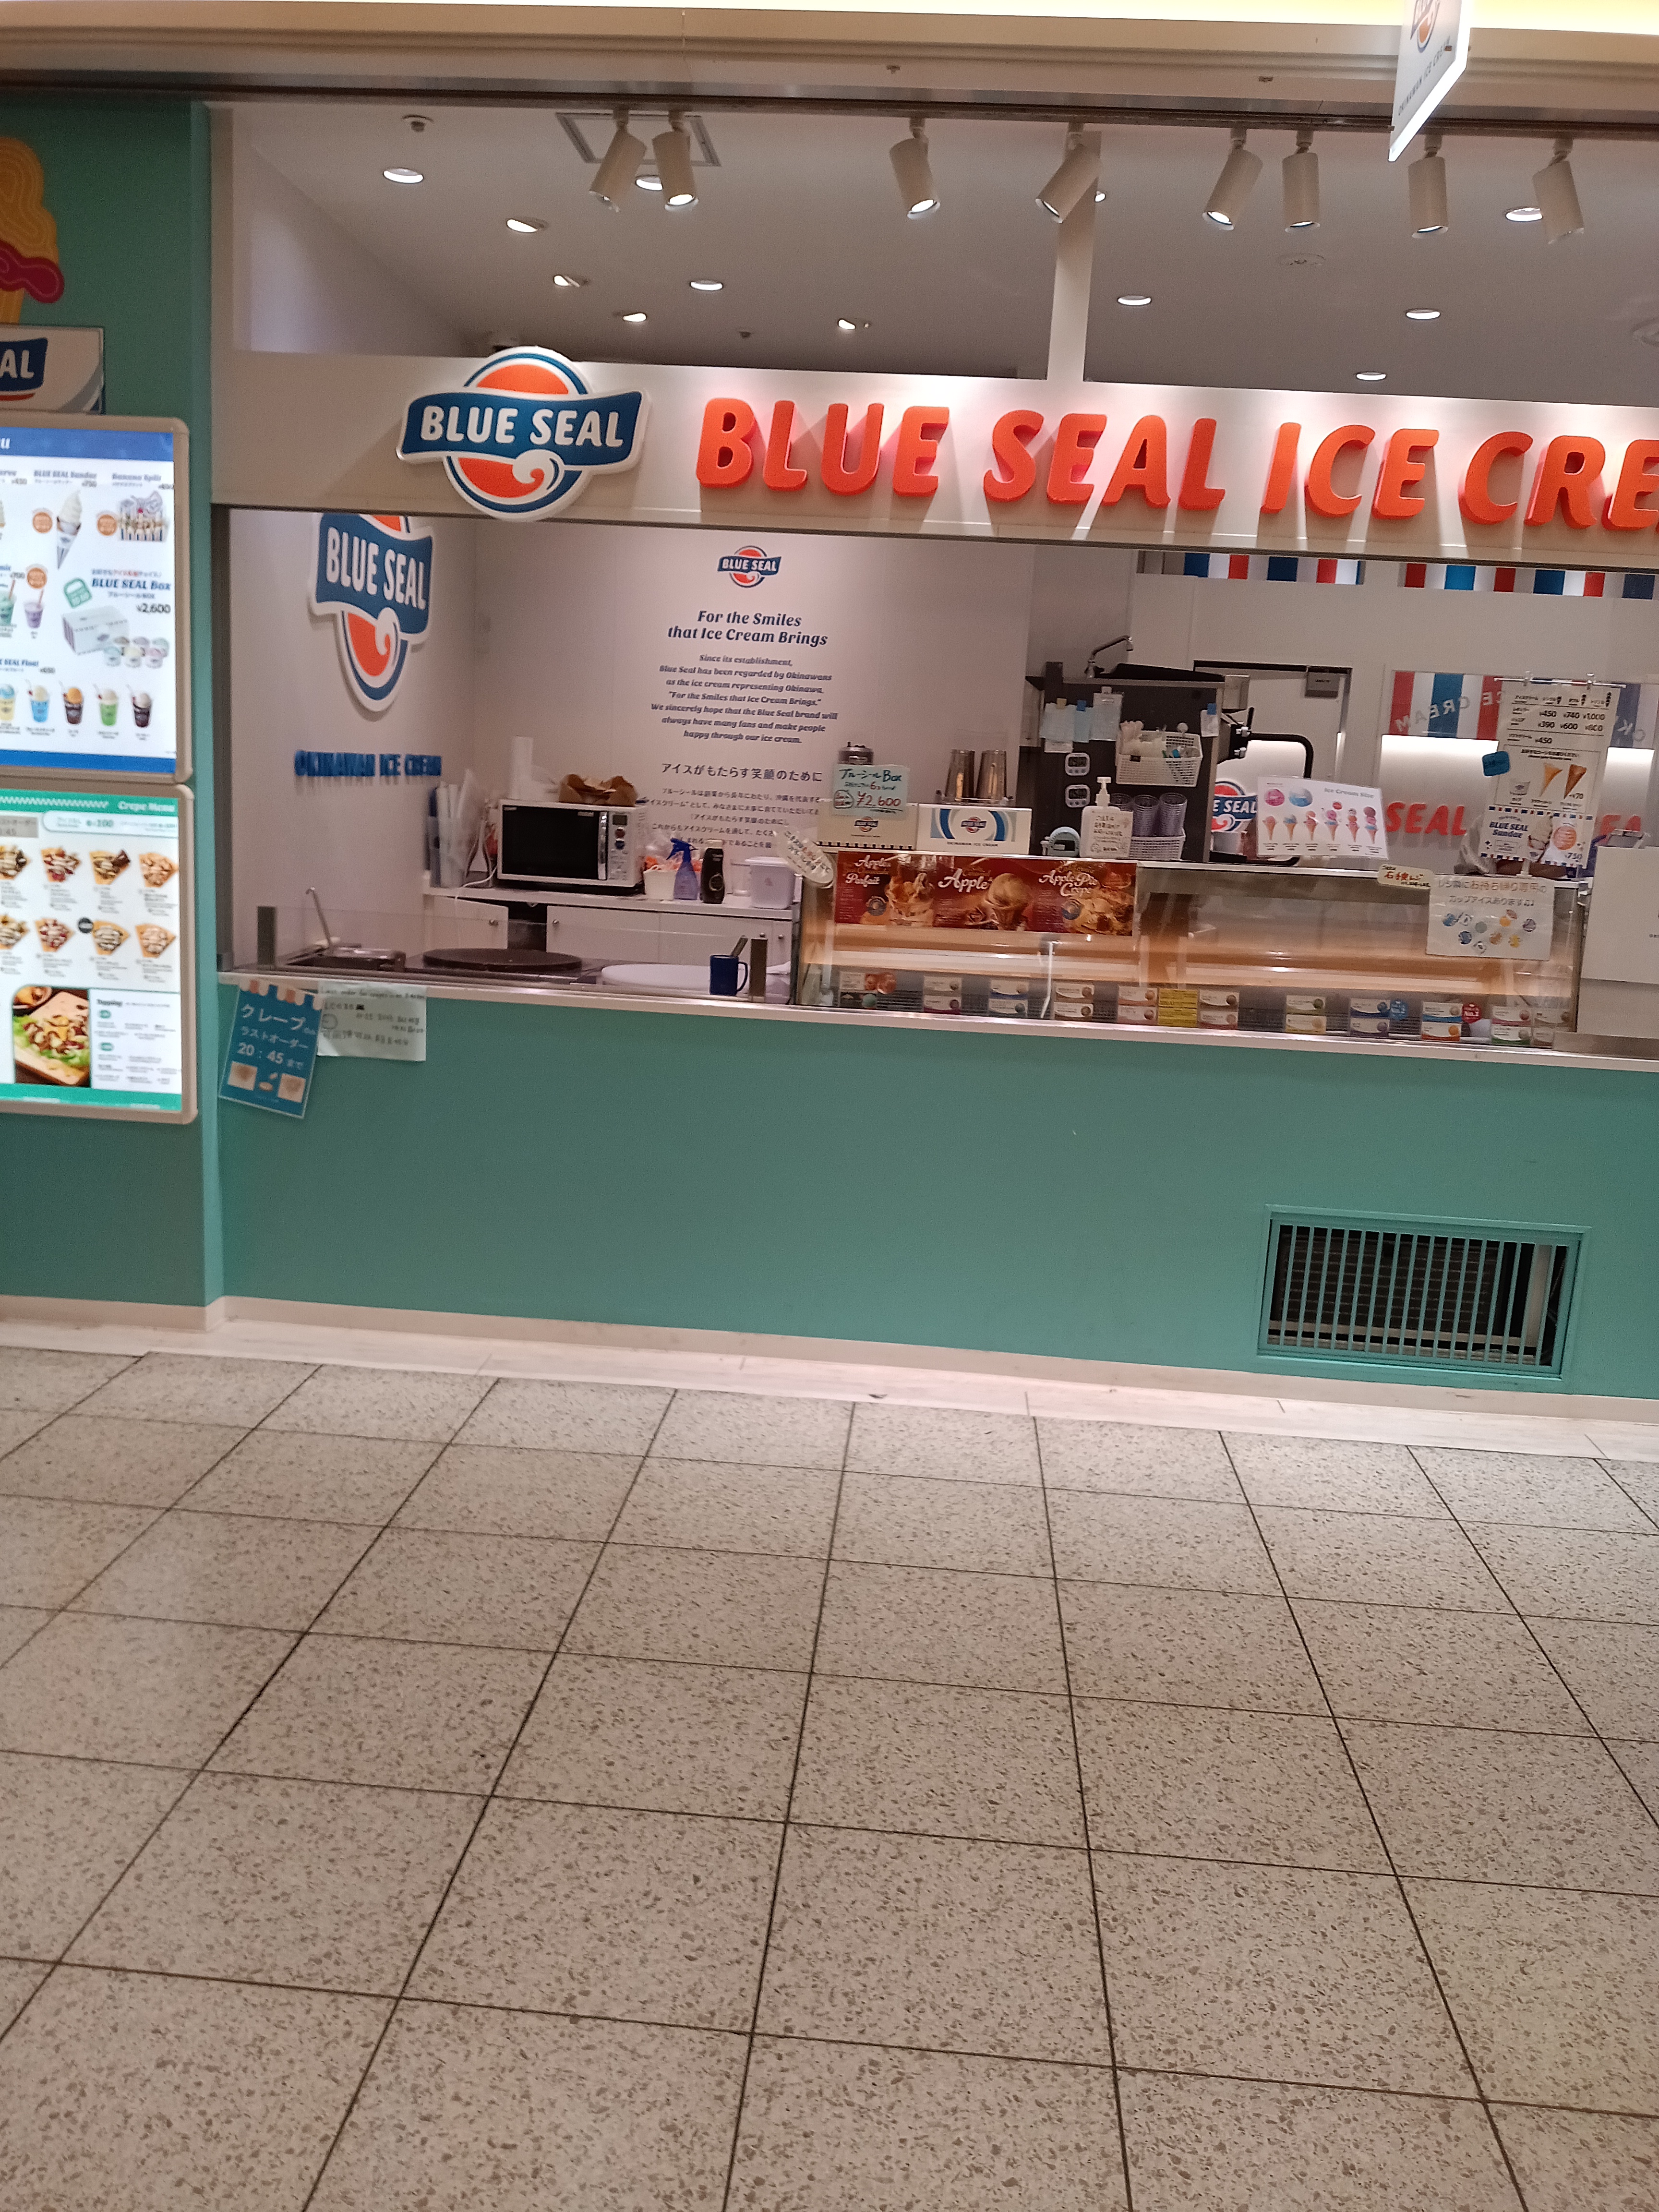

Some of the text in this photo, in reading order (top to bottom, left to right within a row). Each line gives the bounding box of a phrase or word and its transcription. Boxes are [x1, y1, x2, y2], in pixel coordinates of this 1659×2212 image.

[0, 349, 35, 379] AL
[421, 406, 623, 447] BLUE SEAL
[696, 397, 1659, 531] BLUE SEAL ICE CRE
[326, 527, 426, 611] BLUE SEAL
[722, 559, 777, 571] BLUE SEAL
[92, 578, 171, 591] BLUE SEAL Box
[697, 610, 802, 627] For the Smiles
[668, 625, 828, 648] that Ice Cream Brings
[774, 671, 784, 679] by
[786, 672, 832, 681] Okinawans
[731, 683, 783, 692] representing
[665, 704, 702, 713] sincerely
[703, 706, 723, 714] hope
[661, 716, 691, 725] always
[683, 730, 709, 739] happy
[711, 732, 744, 741] through
[661, 763, 823, 782] アイスがもたらす笑顔のために
[883, 769, 902, 782] Box
[1223, 800, 1257, 813] SEAL
[1386, 802, 1467, 836] SEAL
[938, 868, 989, 892] Apple
[1038, 869, 1075, 886] Apple
